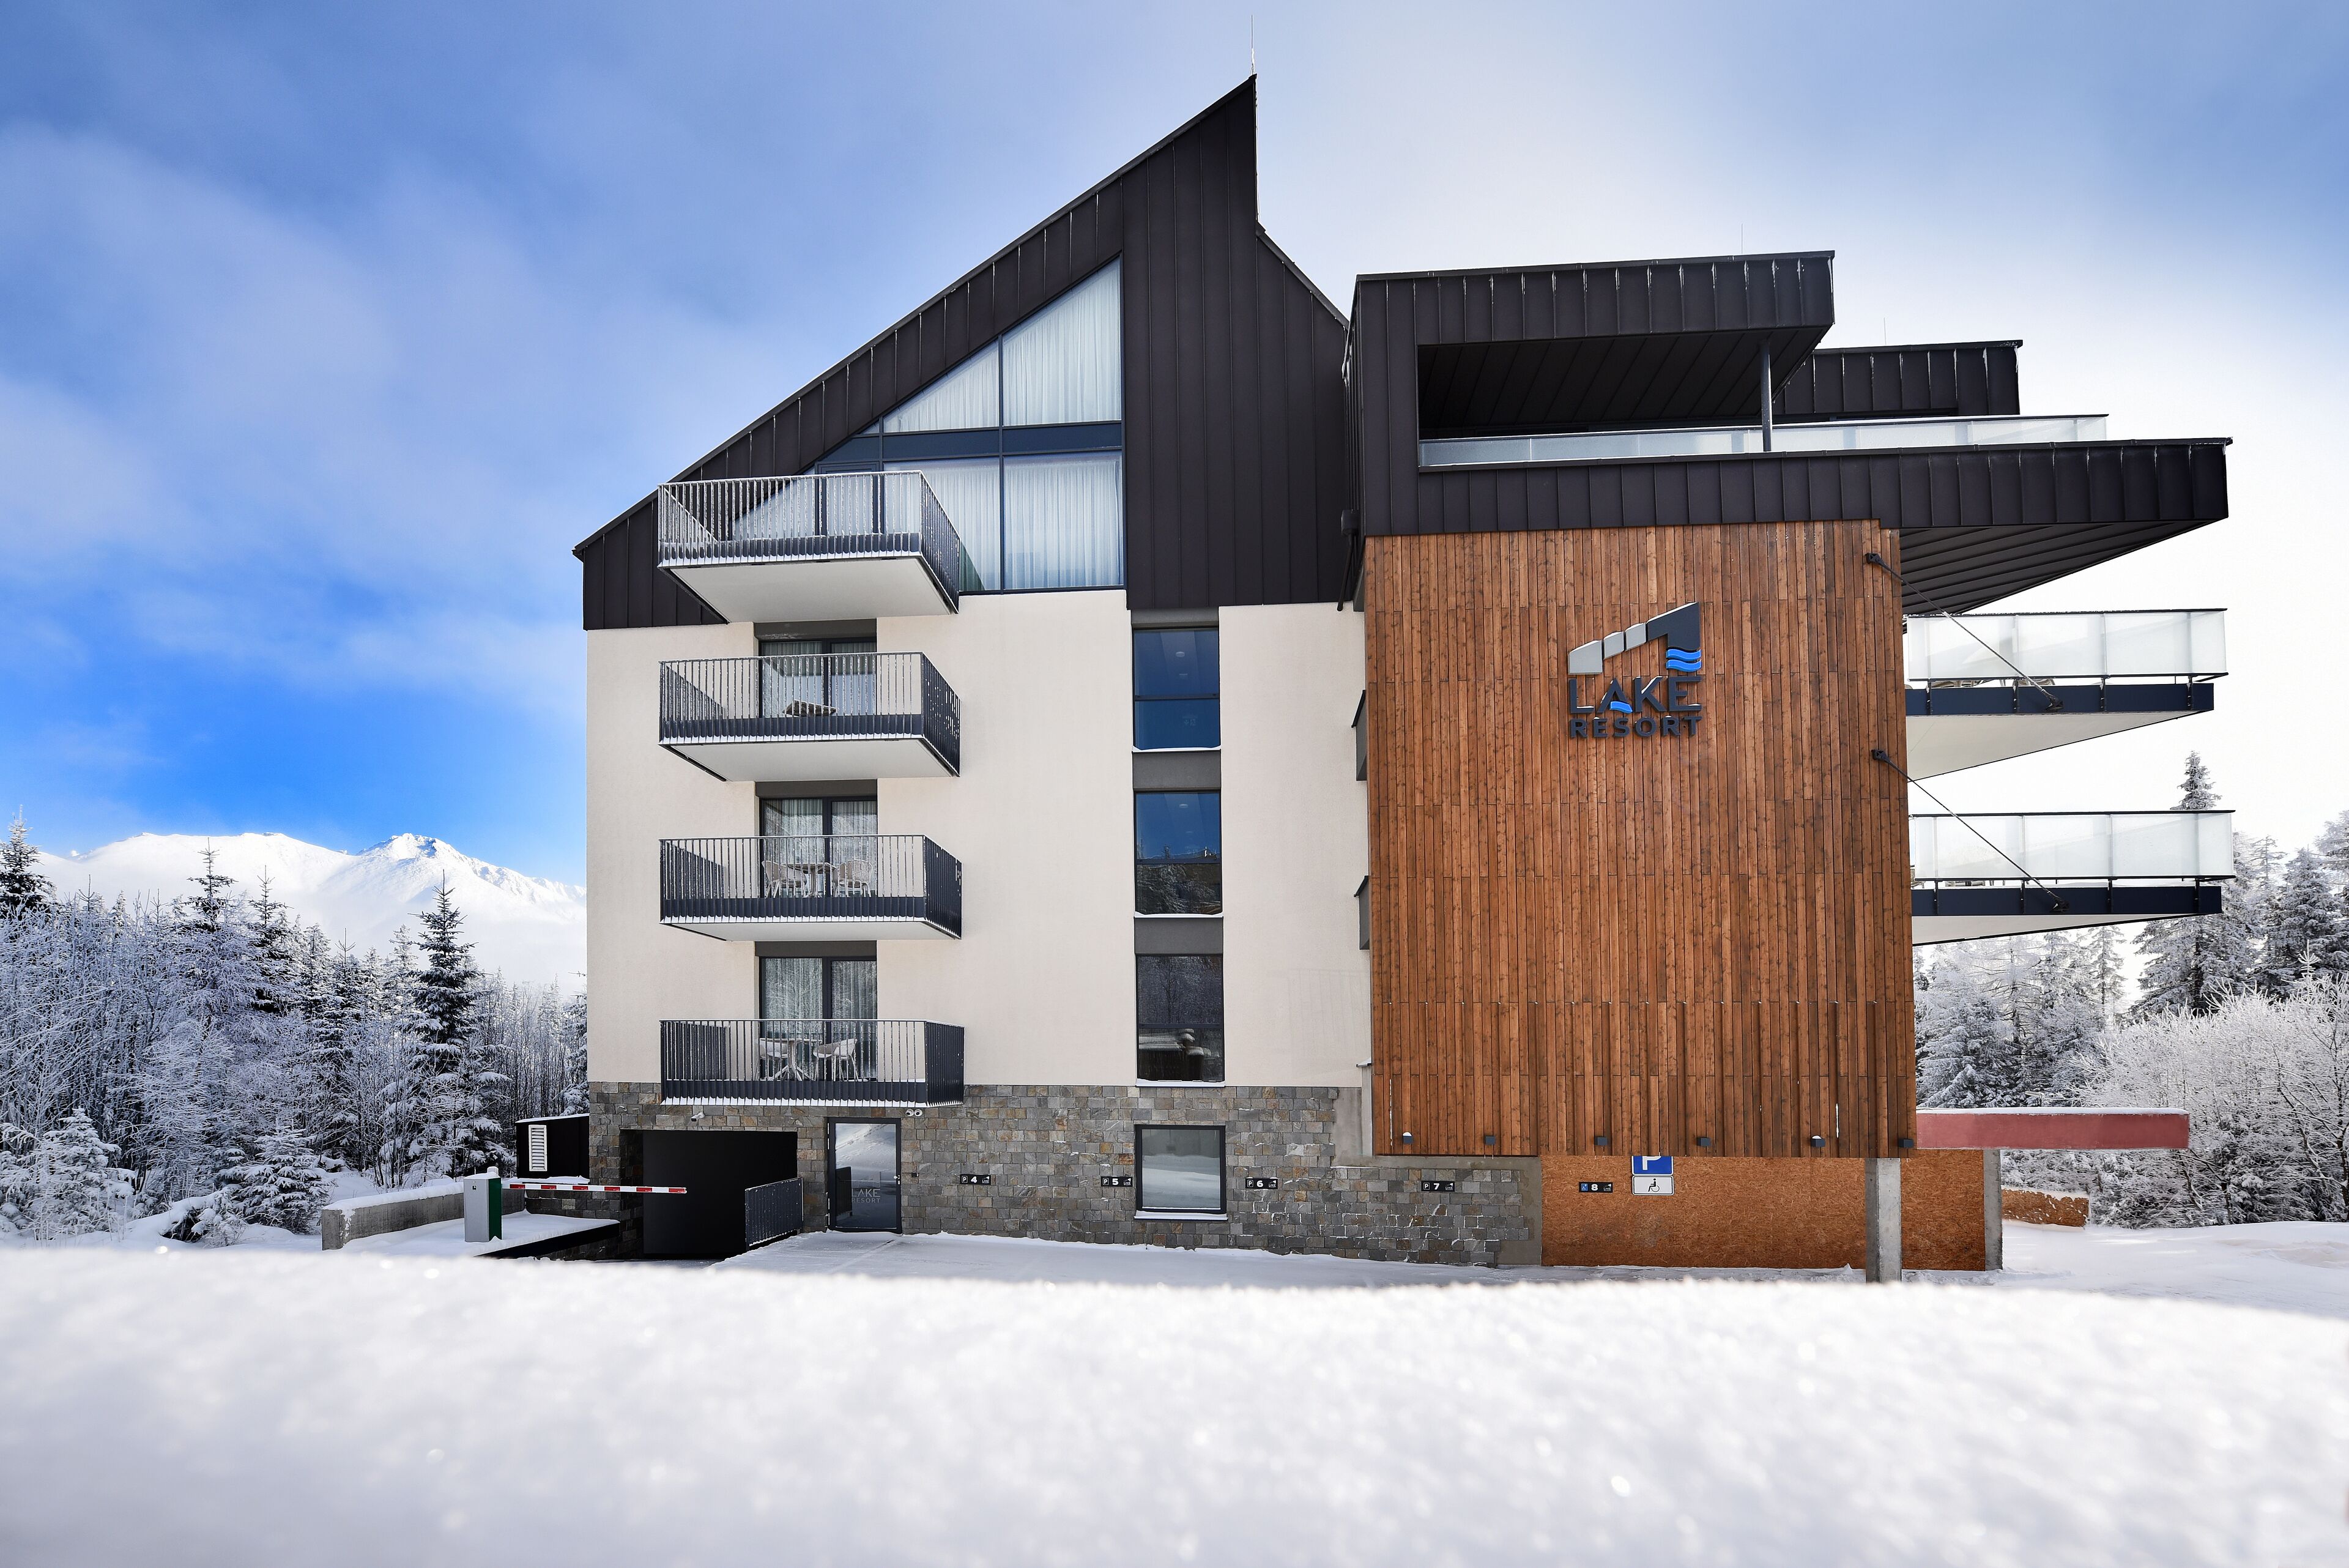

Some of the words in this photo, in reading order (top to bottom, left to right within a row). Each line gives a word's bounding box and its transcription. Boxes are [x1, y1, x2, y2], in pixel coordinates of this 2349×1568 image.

[1568, 675, 1702, 714] LAKE
[1569, 716, 1702, 738] RESORT
[852, 1189, 881, 1197] LAKE
